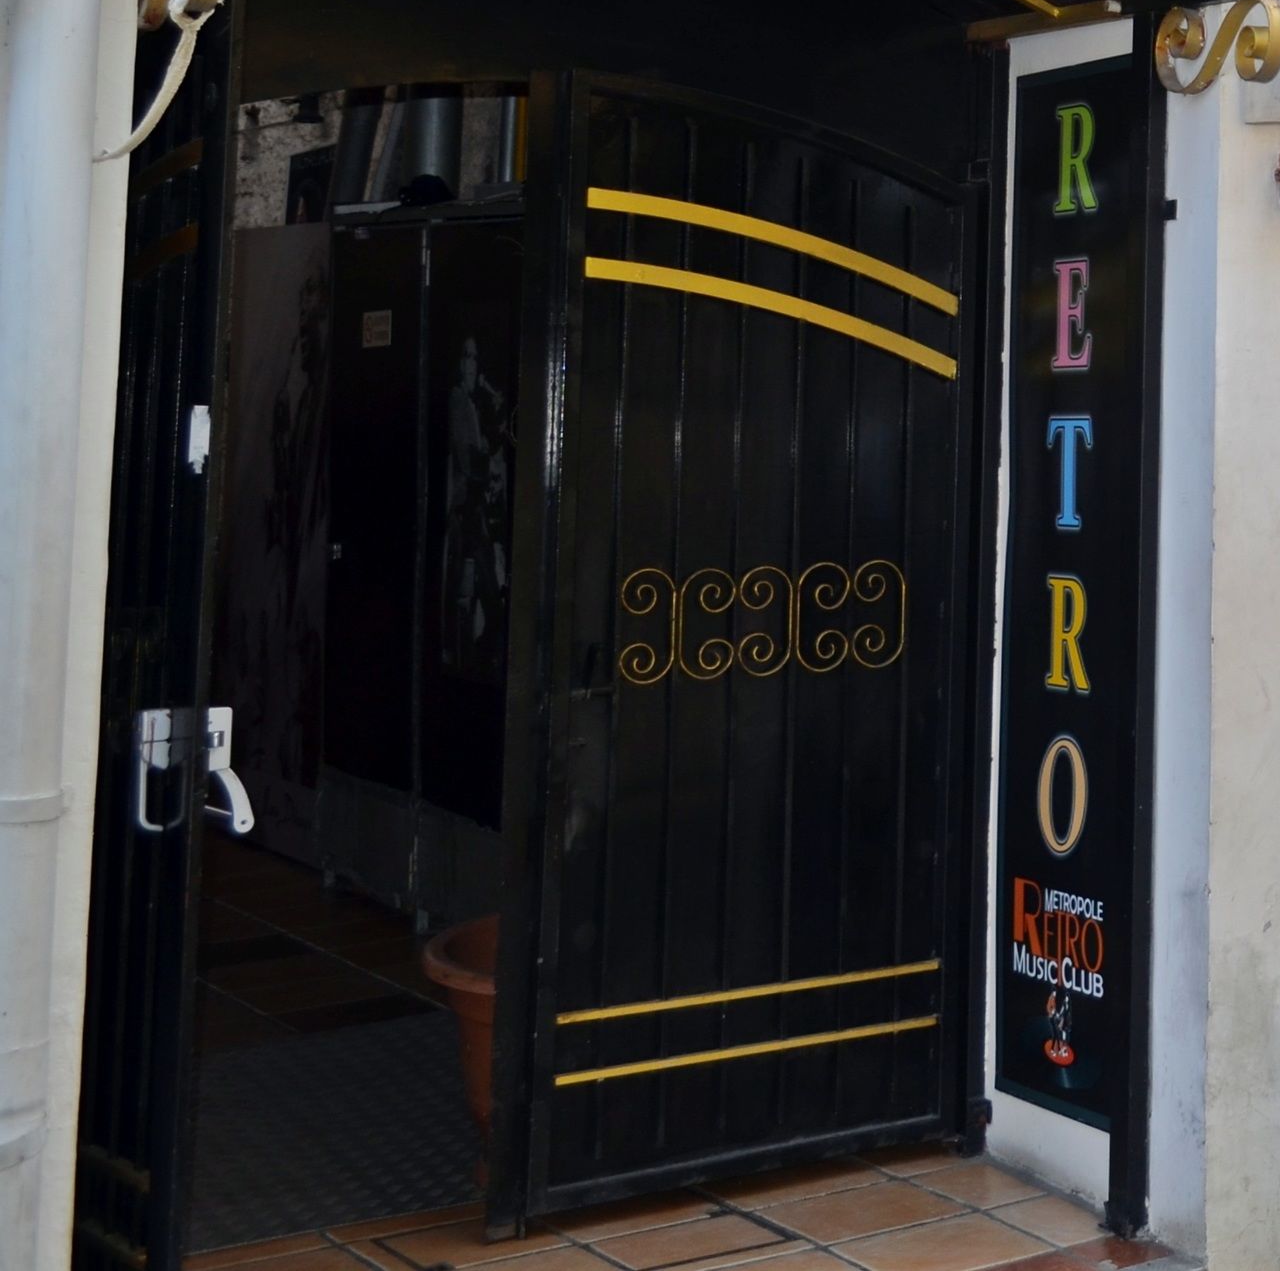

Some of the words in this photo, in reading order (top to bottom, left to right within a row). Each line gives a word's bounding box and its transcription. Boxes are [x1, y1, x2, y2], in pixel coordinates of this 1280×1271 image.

[1035, 103, 1097, 857] RETRO
[1013, 876, 1104, 987] RETRO
[1044, 887, 1104, 922] METROPOLE
[1013, 940, 1058, 985] MUSIC
[1061, 956, 1104, 999] CLUB
